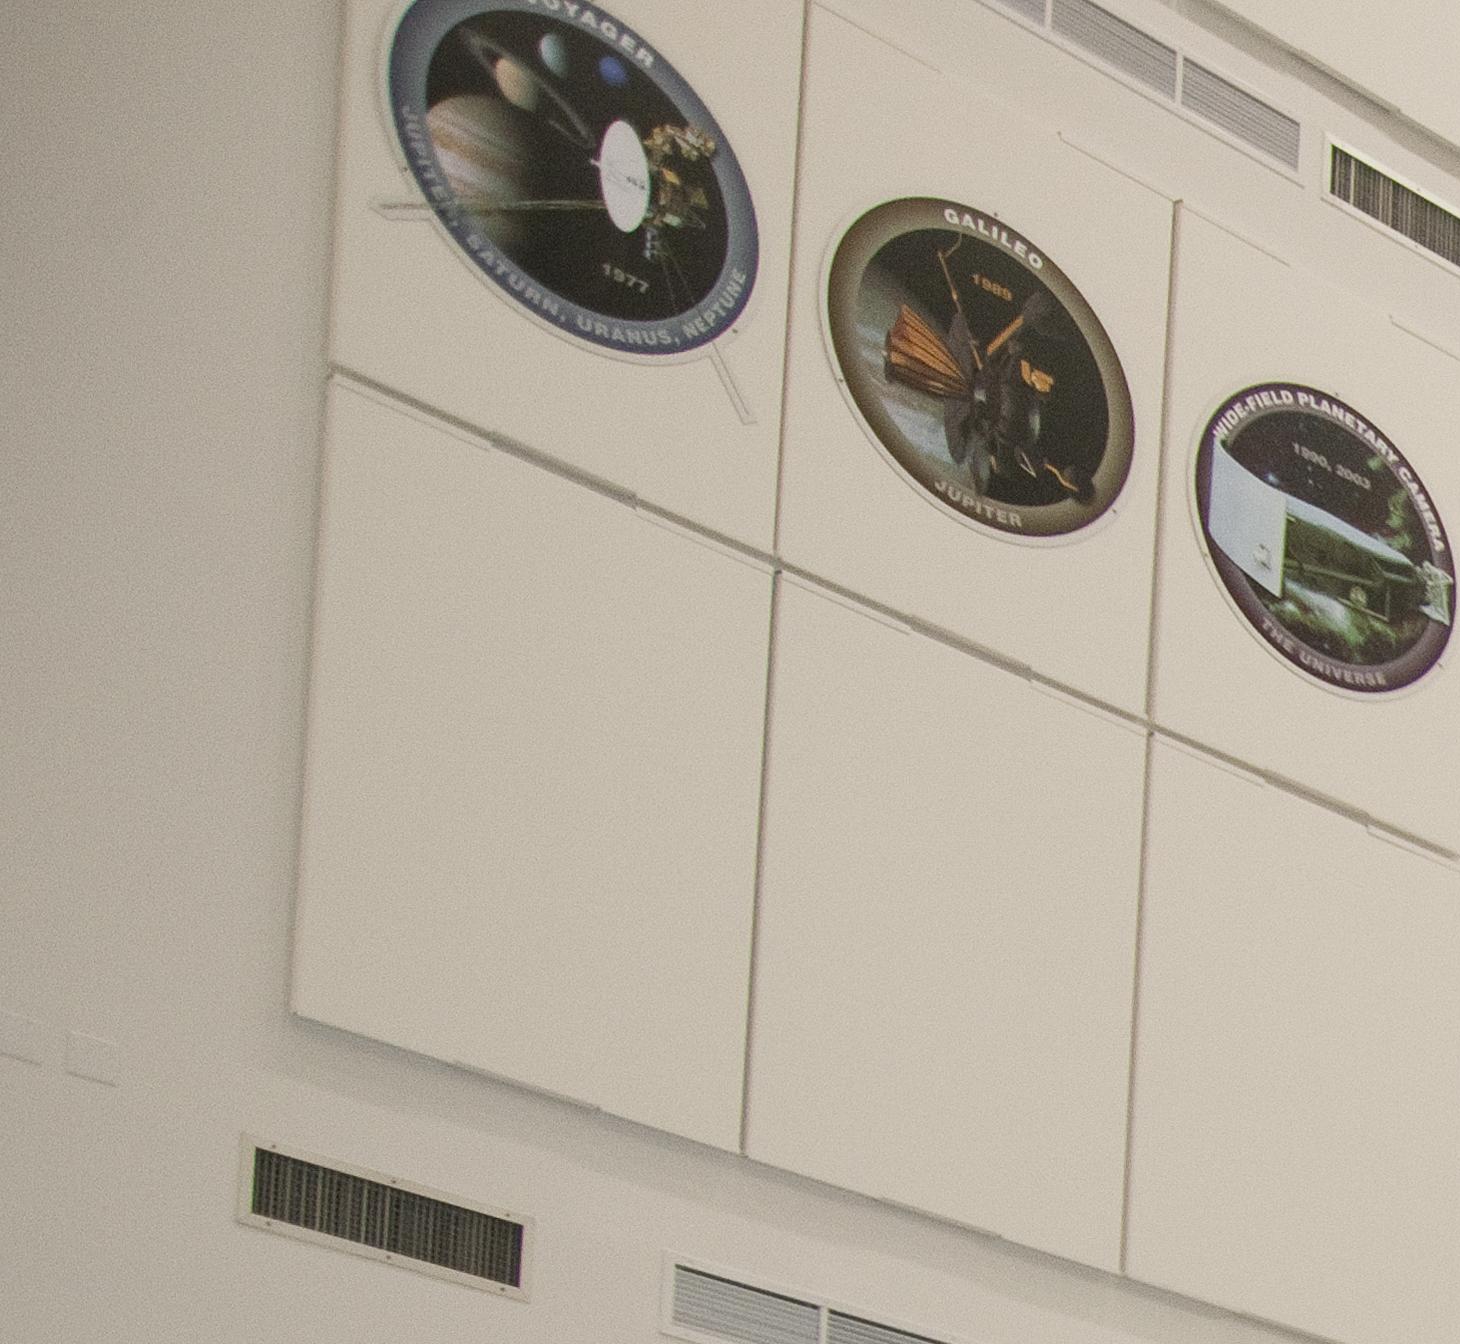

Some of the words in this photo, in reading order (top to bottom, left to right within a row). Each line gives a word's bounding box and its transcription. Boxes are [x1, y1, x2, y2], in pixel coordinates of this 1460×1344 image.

[529, 0, 655, 68] OYAGER
[944, 208, 1043, 269] GALILEO
[468, 234, 568, 323] SATURN,
[577, 317, 682, 346] URANUS,
[683, 270, 747, 340] NEPTUNE
[602, 263, 649, 293] 1977
[971, 273, 1013, 301] 1989
[1213, 390, 1294, 437] WIDE-FIELD
[1297, 391, 1399, 463] PLANETARY
[1399, 466, 1445, 552] CAMERA
[934, 480, 1023, 528] JUPITER
[1261, 619, 1294, 651] THE
[1299, 651, 1387, 686] UNIVERSE
